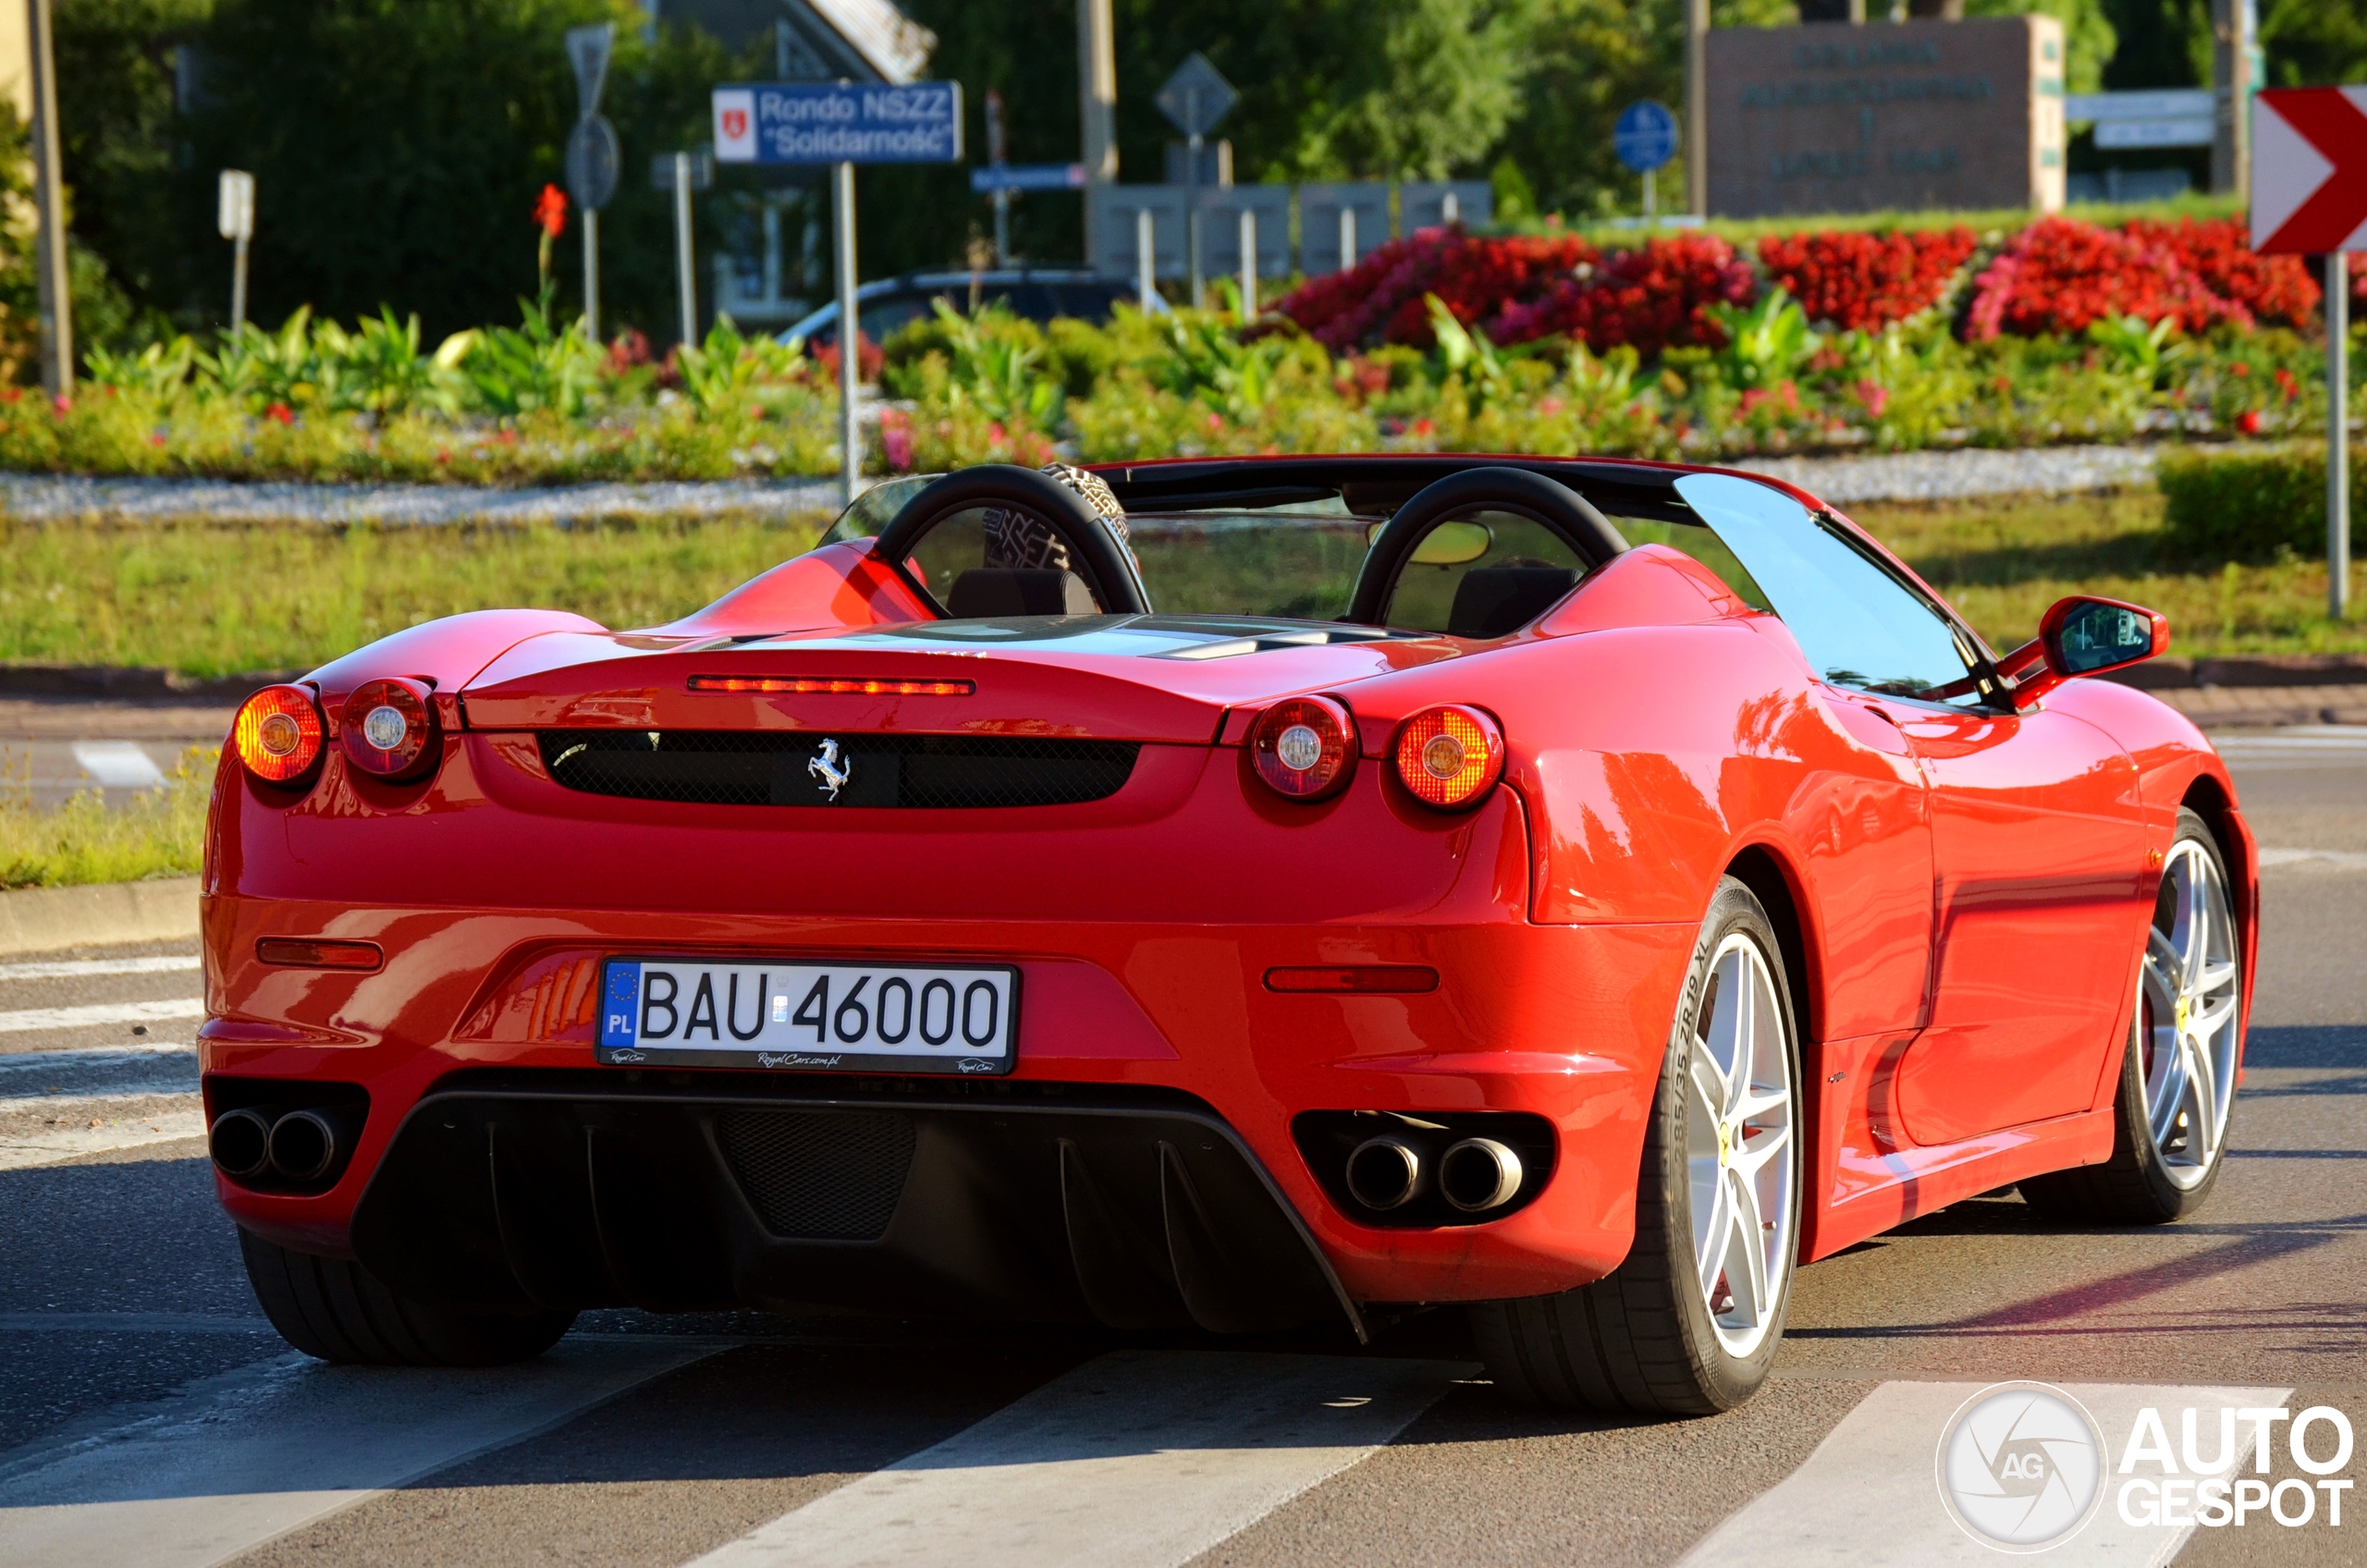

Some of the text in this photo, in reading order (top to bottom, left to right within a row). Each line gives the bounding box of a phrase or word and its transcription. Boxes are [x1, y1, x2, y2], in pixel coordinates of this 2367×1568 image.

[759, 90, 948, 120] Rondo NSZZ
[608, 1014, 632, 1034] PL
[640, 971, 999, 1047] BAU 46000
[1674, 1054, 1686, 1163] 285/35
[1695, 941, 1709, 970] XL
